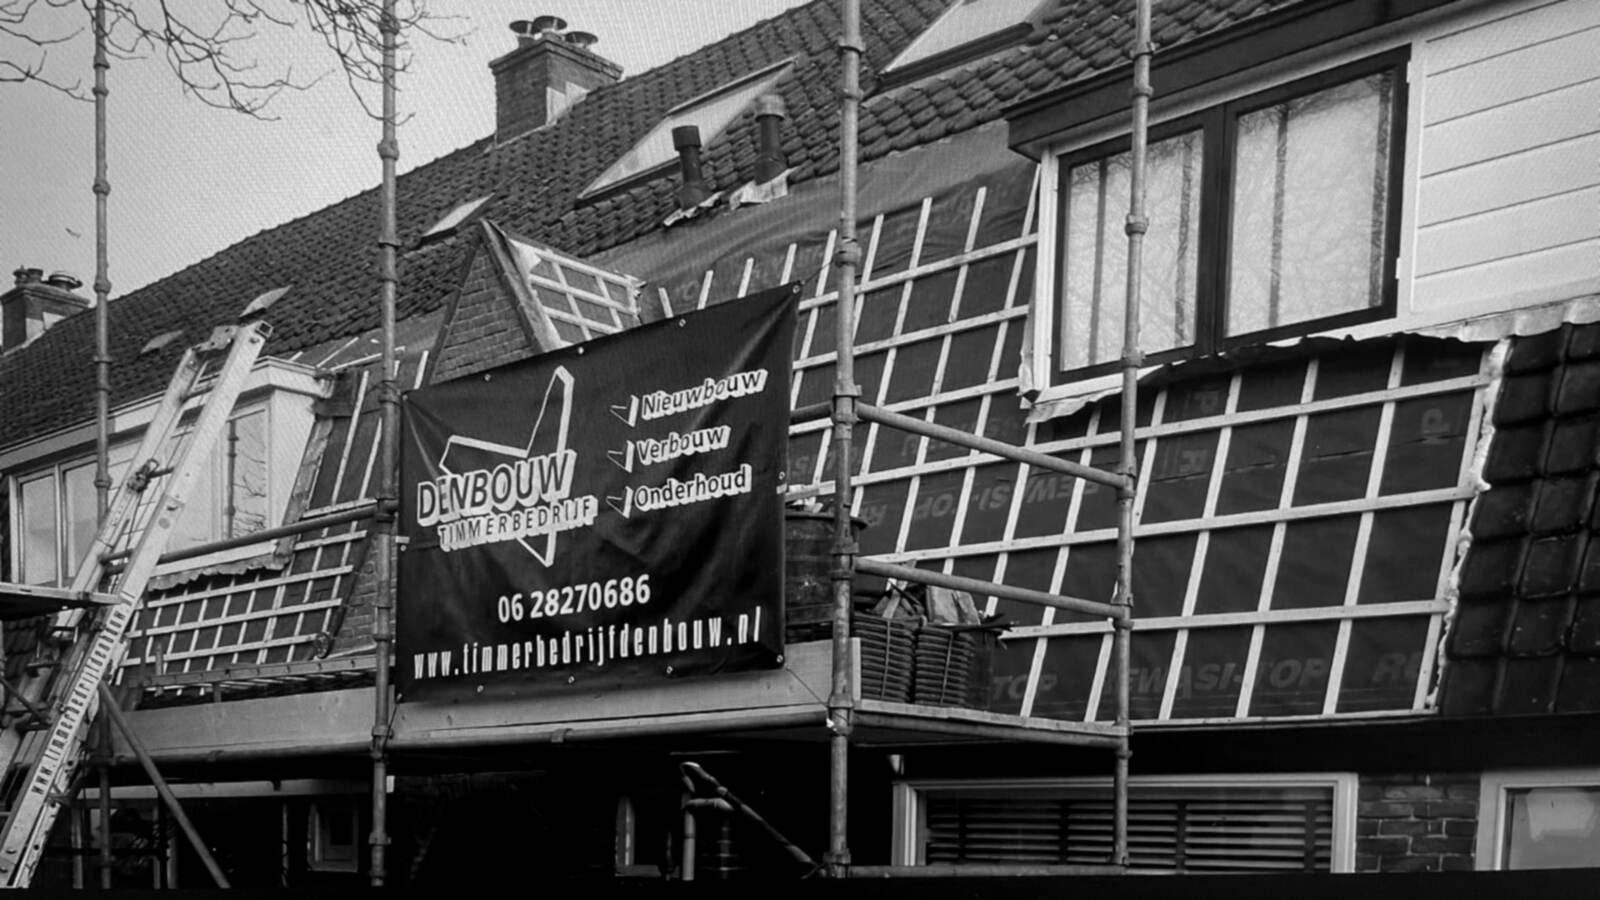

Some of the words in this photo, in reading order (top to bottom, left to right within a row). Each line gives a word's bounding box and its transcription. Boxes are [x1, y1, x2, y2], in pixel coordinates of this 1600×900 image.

[641, 369, 768, 420] Nieuwbouw
[636, 425, 731, 466] Verbouw
[417, 449, 577, 526] DENBOUW
[634, 463, 752, 512] Onderhoud
[437, 494, 598, 551] TIMMERBEDRIJF
[498, 594, 523, 623] 06
[530, 573, 651, 619] 28270686
[413, 605, 762, 679] www.timmerbedrijfdenbouw.nl
